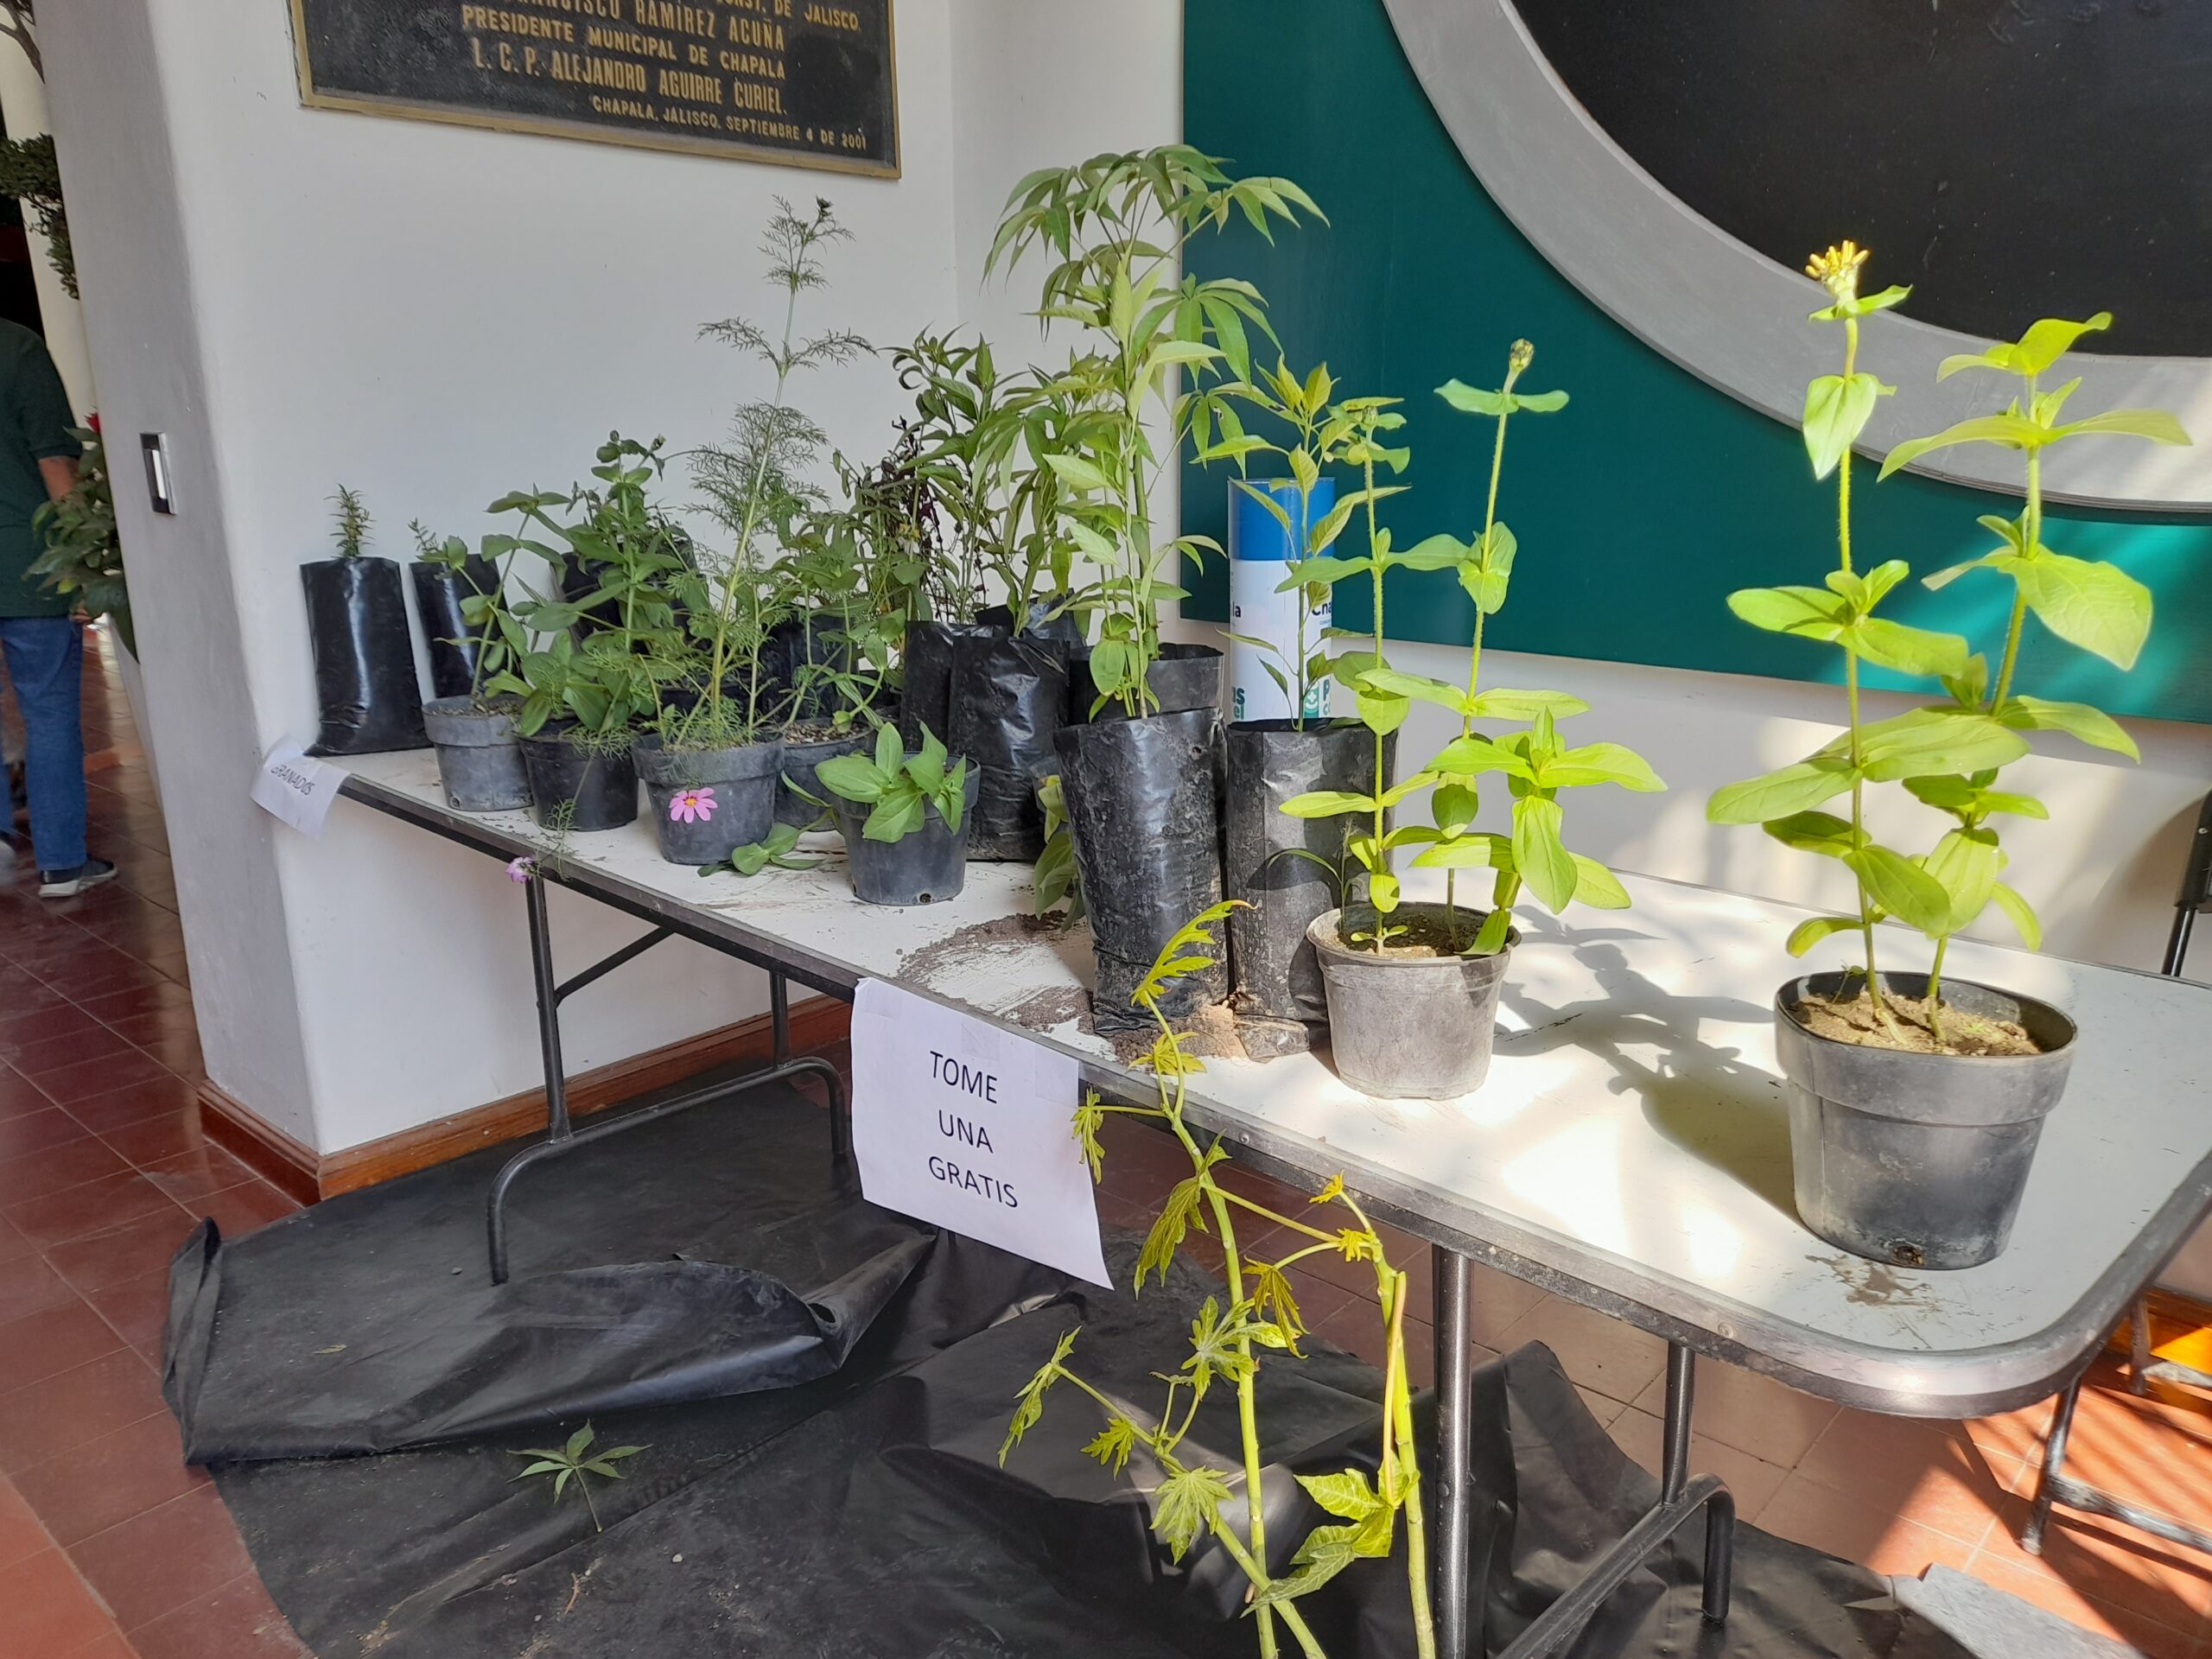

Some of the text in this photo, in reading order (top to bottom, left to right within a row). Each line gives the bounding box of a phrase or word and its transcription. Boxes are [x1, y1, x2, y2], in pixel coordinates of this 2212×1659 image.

[774, 0, 792, 18] DE
[461, 3, 575, 42] PRESIDENTE
[587, 25, 677, 60] MUNICIPAL
[689, 43, 709, 66] DE
[719, 50, 786, 80] CHAPALA
[728, 16, 785, 52] ACUÑA
[471, 37, 492, 69] L.
[499, 41, 519, 73] C.
[524, 46, 540, 77] P.
[551, 49, 647, 93] ALEJANDRO
[658, 68, 723, 105] AGUIRRE
[726, 115, 800, 142] SEPTIEMBRE
[805, 127, 814, 143] 4
[820, 128, 835, 146] DE
[841, 131, 867, 151] 2001
[929, 1050, 998, 1104] TOME
[938, 1109, 995, 1154] UNA
[928, 1154, 1019, 1209] GRATIS
